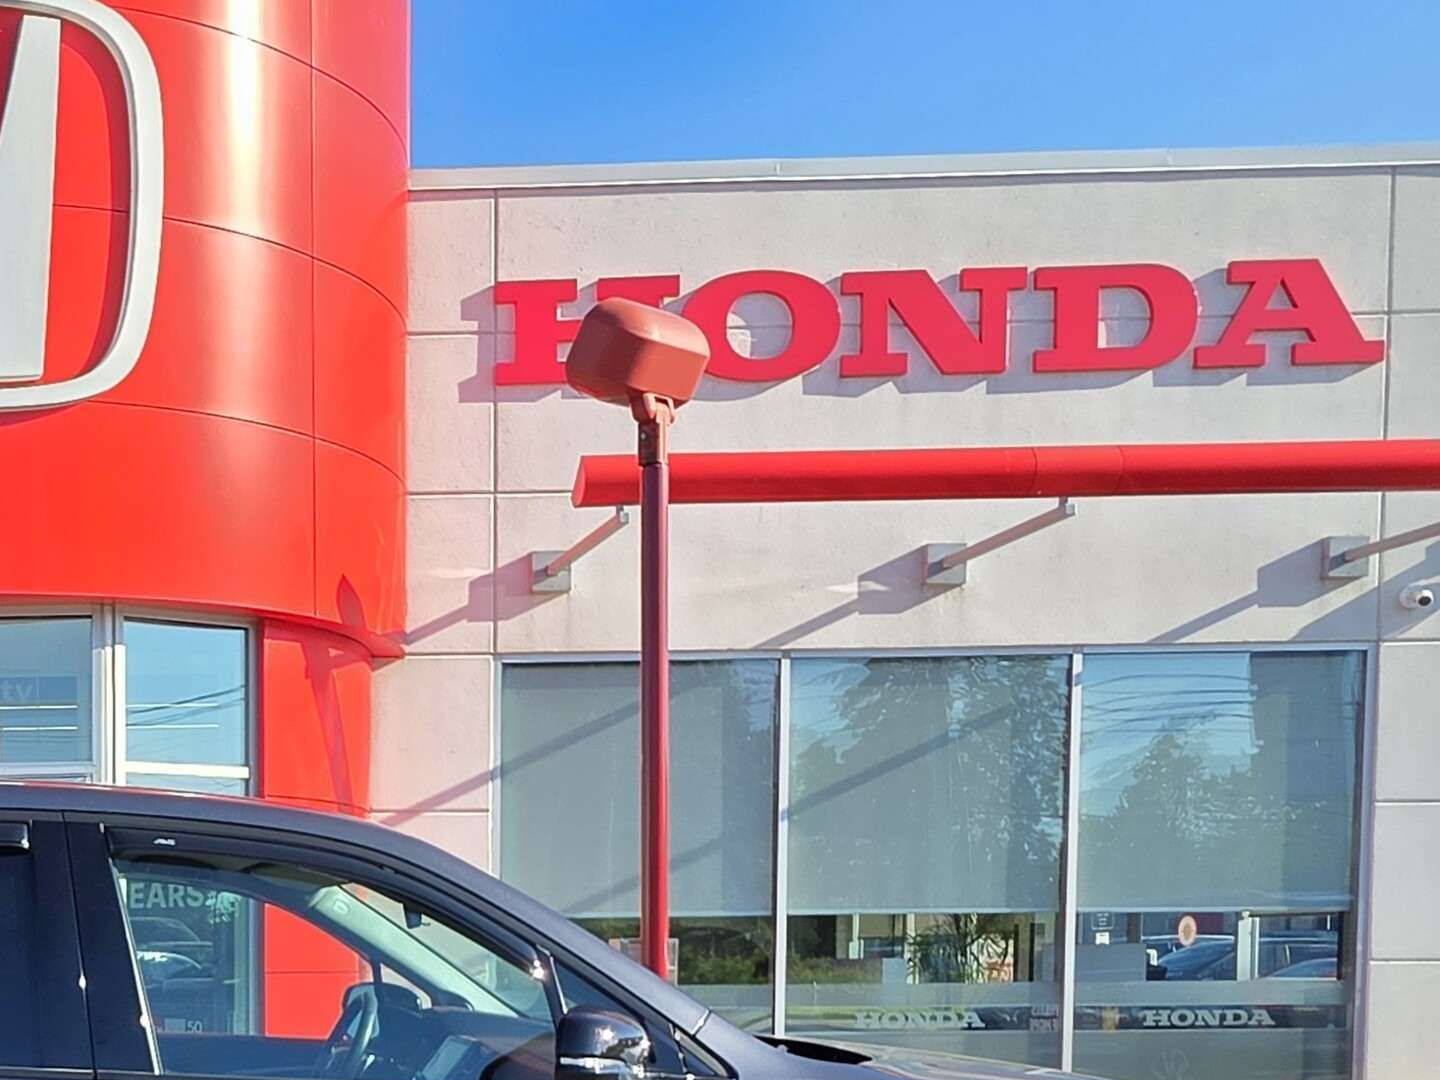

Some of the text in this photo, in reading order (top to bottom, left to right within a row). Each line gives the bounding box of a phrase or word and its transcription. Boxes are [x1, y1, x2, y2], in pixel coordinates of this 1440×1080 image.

[494, 258, 1385, 385] HONDA
[130, 882, 204, 909] EARS
[854, 1011, 986, 1029] HONDA
[1142, 1009, 1276, 1027] HONDA
